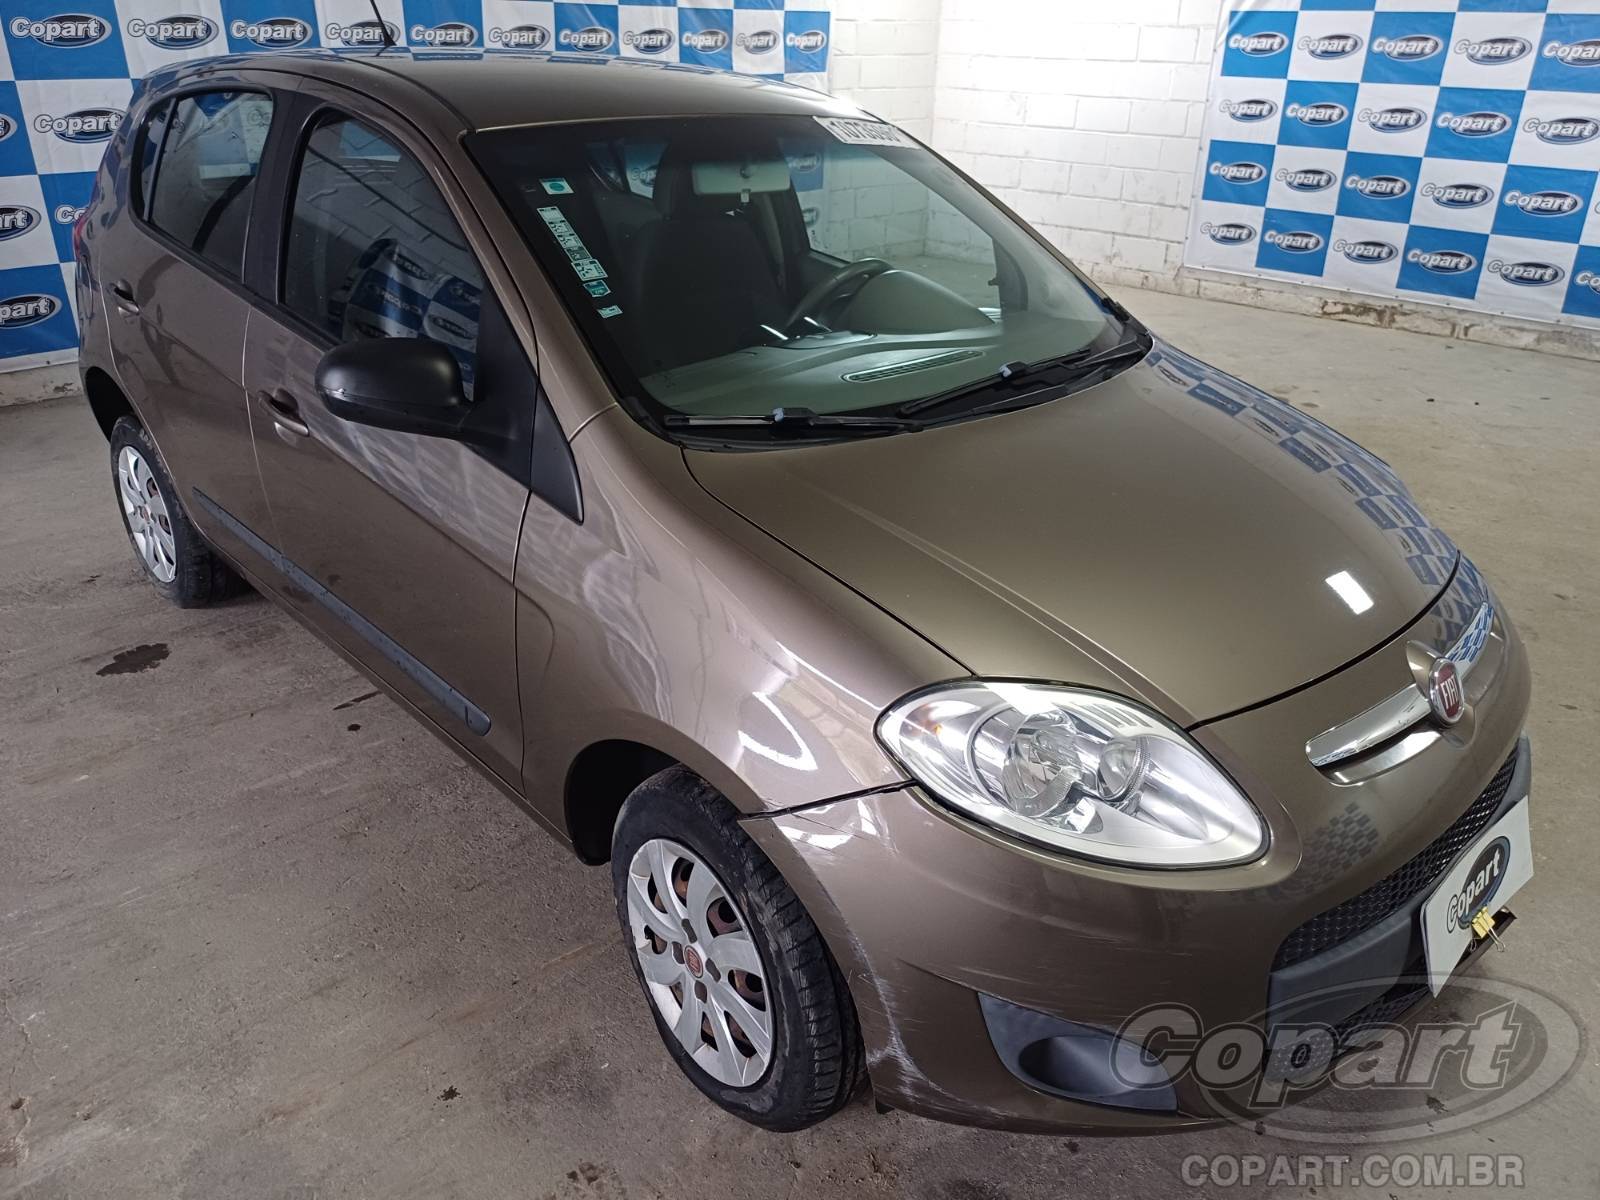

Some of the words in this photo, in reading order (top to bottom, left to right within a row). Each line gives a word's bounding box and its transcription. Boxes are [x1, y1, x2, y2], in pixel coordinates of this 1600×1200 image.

[10, 17, 99, 41] Copart
[127, 18, 206, 42] Copart
[231, 22, 303, 42] Copart
[326, 23, 385, 43] Copar
[410, 24, 471, 44] Copart
[489, 26, 542, 48] Copart
[559, 27, 609, 48] Copart
[682, 29, 723, 47] Copart
[623, 30, 668, 49] Copart
[736, 31, 774, 49] Copart
[786, 31, 822, 47] Copart
[1229, 33, 1279, 52] Copart
[1298, 35, 1355, 54] Copart
[1372, 38, 1434, 56] Copart
[1454, 38, 1519, 58] Copart
[1220, 99, 1270, 118] Copart
[1286, 104, 1341, 122] Copart
[1358, 108, 1418, 127] Copart
[34, 112, 119, 137] Copart
[1436, 113, 1501, 131] Copart
[1523, 117, 1592, 139] Copart
[1210, 162, 1258, 179] Copart
[1275, 168, 1329, 186] Copart
[1345, 175, 1402, 193] Copart
[1422, 183, 1484, 203] Copart
[1505, 191, 1574, 213] Copart
[1201, 222, 1248, 240] Copart
[1264, 230, 1317, 248] Copart
[1334, 241, 1390, 258] Copart
[1408, 249, 1468, 268] Copart
[1488, 260, 1556, 281] Copart
[0, 297, 50, 324] part
[1447, 847, 1500, 934] Copart
